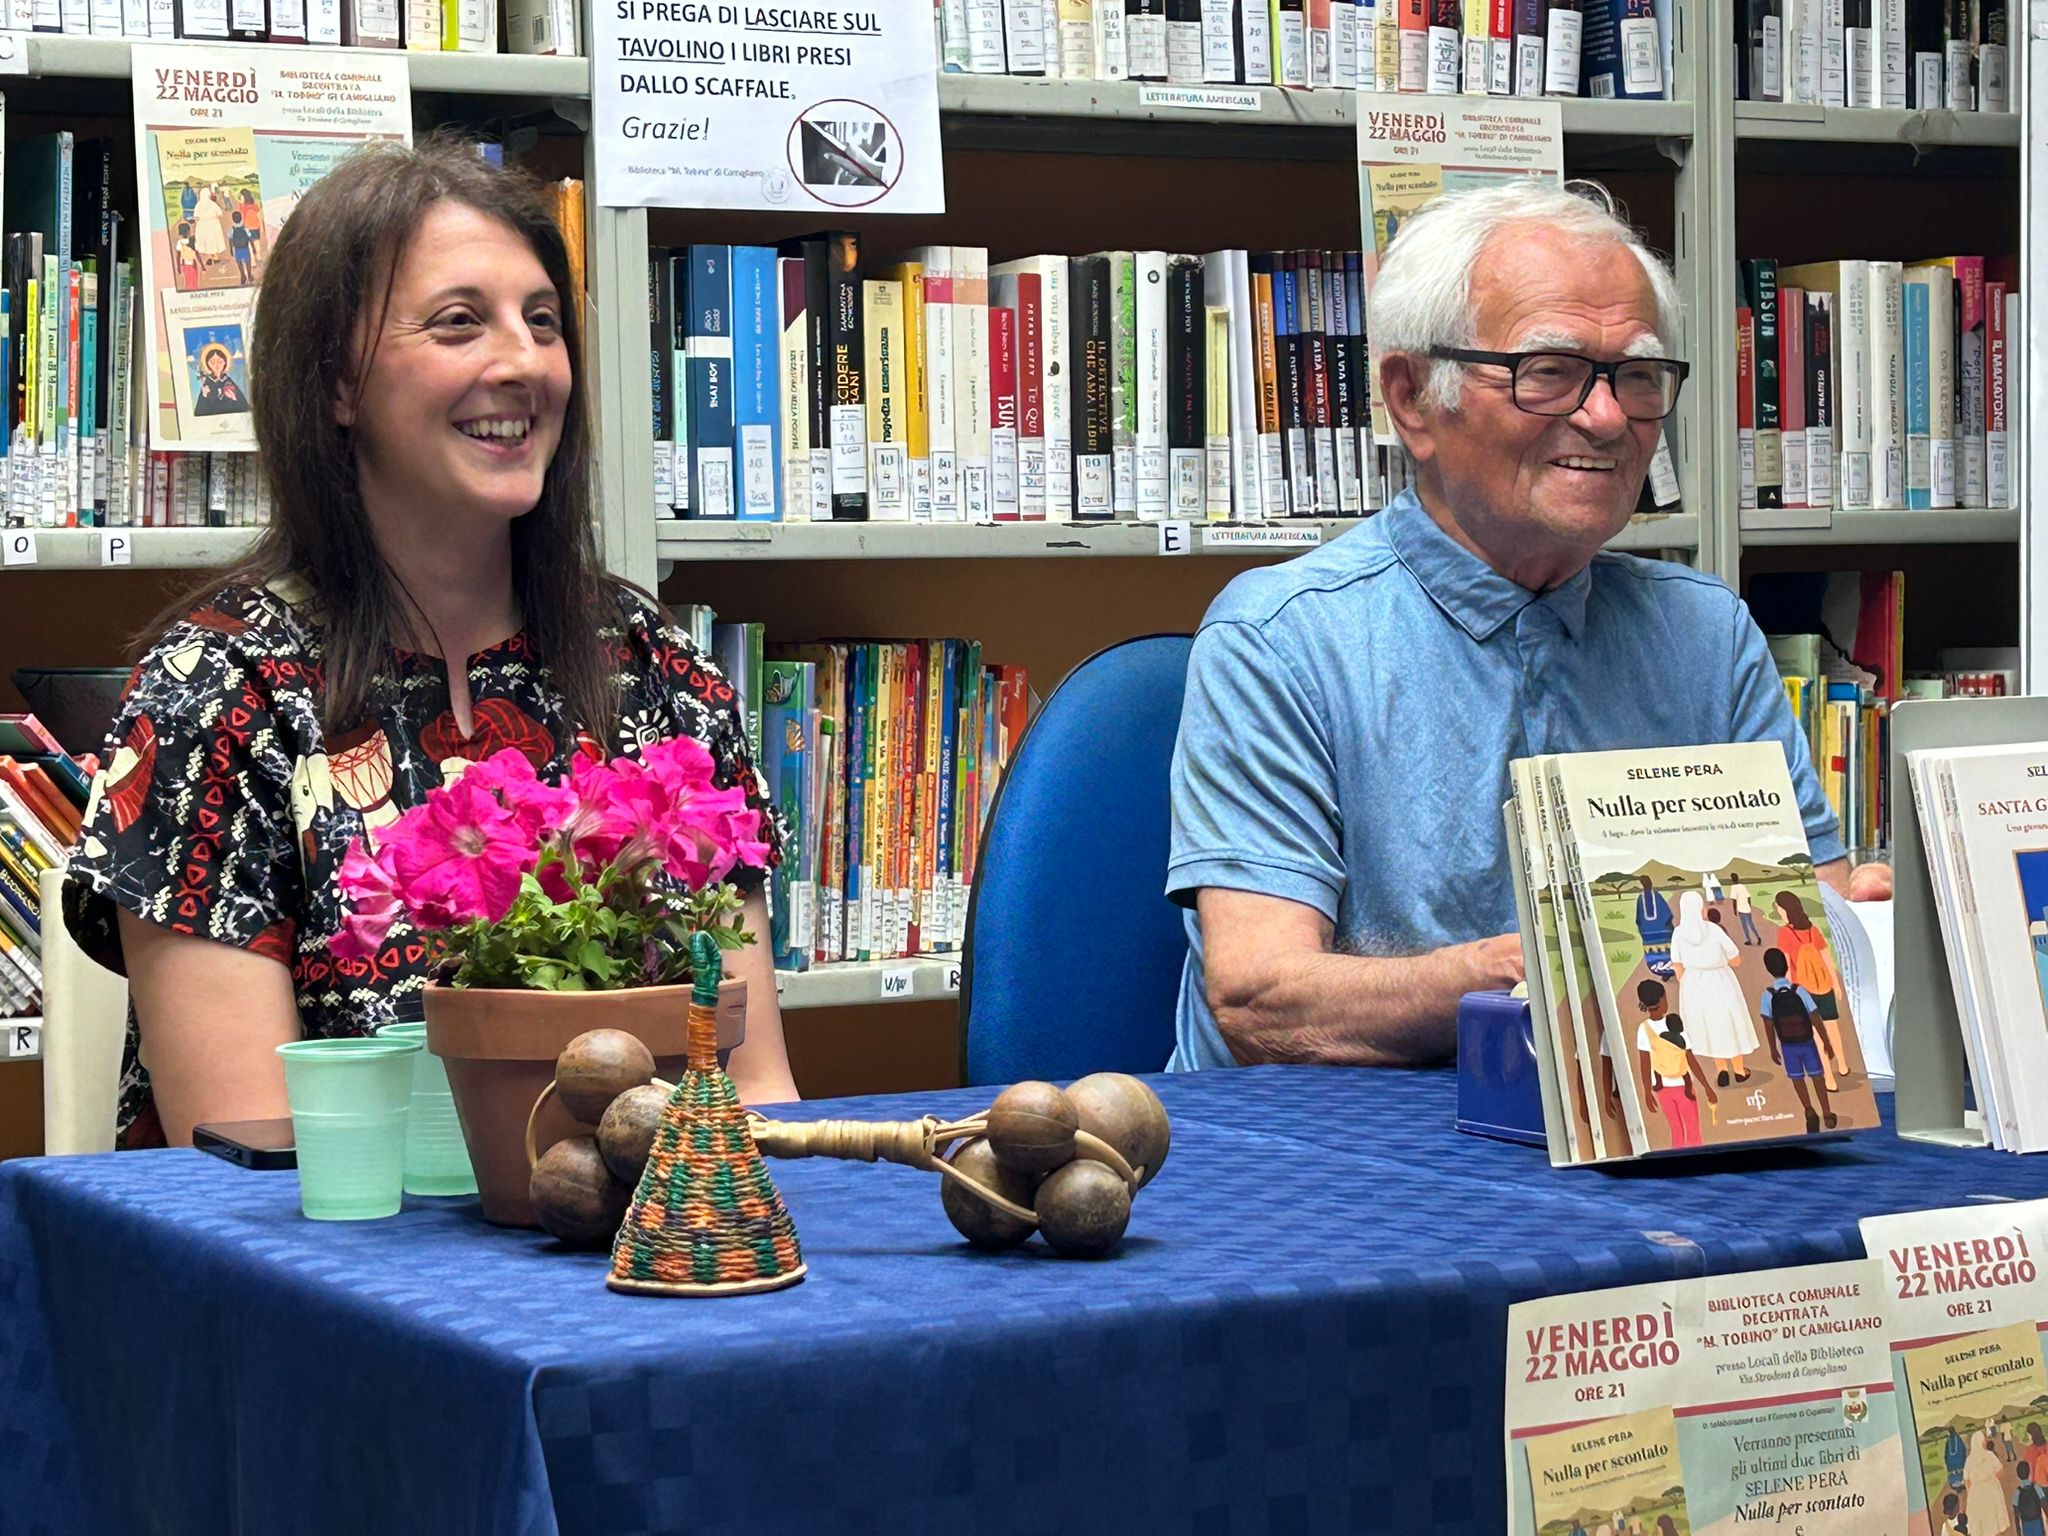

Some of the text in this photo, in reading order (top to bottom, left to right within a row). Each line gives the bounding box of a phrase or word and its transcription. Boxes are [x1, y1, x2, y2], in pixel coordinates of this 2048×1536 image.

[616, 1, 881, 32] SI PREGA DI LASCIARE SUL
[617, 37, 852, 66] TAVOLINO I LIBRI PRESI
[155, 67, 257, 88] VENERDÌ
[620, 74, 796, 100] DALLO SCAFFALE.
[156, 85, 259, 104] 22 MAGGIO
[622, 116, 710, 141] Grazie!
[1368, 111, 1445, 130] VENERDÌ
[1369, 126, 1447, 144] 22 MAGGIO
[1086, 340, 1096, 368] CHE
[1086, 371, 1097, 404] AMA
[109, 538, 125, 562] P
[1164, 526, 1179, 552] E
[1627, 764, 1724, 780] SELENE PERA
[1586, 788, 1782, 820] Nulla per scontato
[1978, 799, 2033, 816] SANTA
[16, 1026, 32, 1051] R
[1888, 1225, 2030, 1274] VENERDÌ
[1896, 1259, 2037, 1300] 22 MAGGIO
[1707, 1283, 1861, 1313] BIBLIOTECA COMUNALE
[1946, 1299, 1993, 1318] ORE 21
[1525, 1301, 1675, 1356] VENERDÌ
[1742, 1304, 1830, 1327] DECENTRATA
[1782, 1325, 1796, 1340] DI
[1799, 1315, 1883, 1337] CAMIGLIANO
[1525, 1340, 1680, 1383] 22 MAGGIO
[1782, 1350, 1808, 1364] della
[1810, 1344, 1865, 1362] Biblioteca
[1919, 1373, 1957, 1395] Nulla
[1957, 1371, 1980, 1389] per
[1981, 1355, 2035, 1380] scontato
[1574, 1382, 1626, 1402] ORE 21
[1608, 1430, 1634, 1445] PERA
[1732, 1433, 1792, 1453] Verranno
[1543, 1463, 1582, 1486] Nulla
[1584, 1460, 1609, 1480] per
[1610, 1443, 1669, 1469] scontato
[1730, 1459, 1747, 1482] gli
[1750, 1454, 1788, 1475] ultimi
[1790, 1451, 1816, 1469] due
[1846, 1444, 1861, 1462] di
[1744, 1469, 1850, 1498] SELENE PERA
[1733, 1492, 1866, 1524] Nulla per scontato
